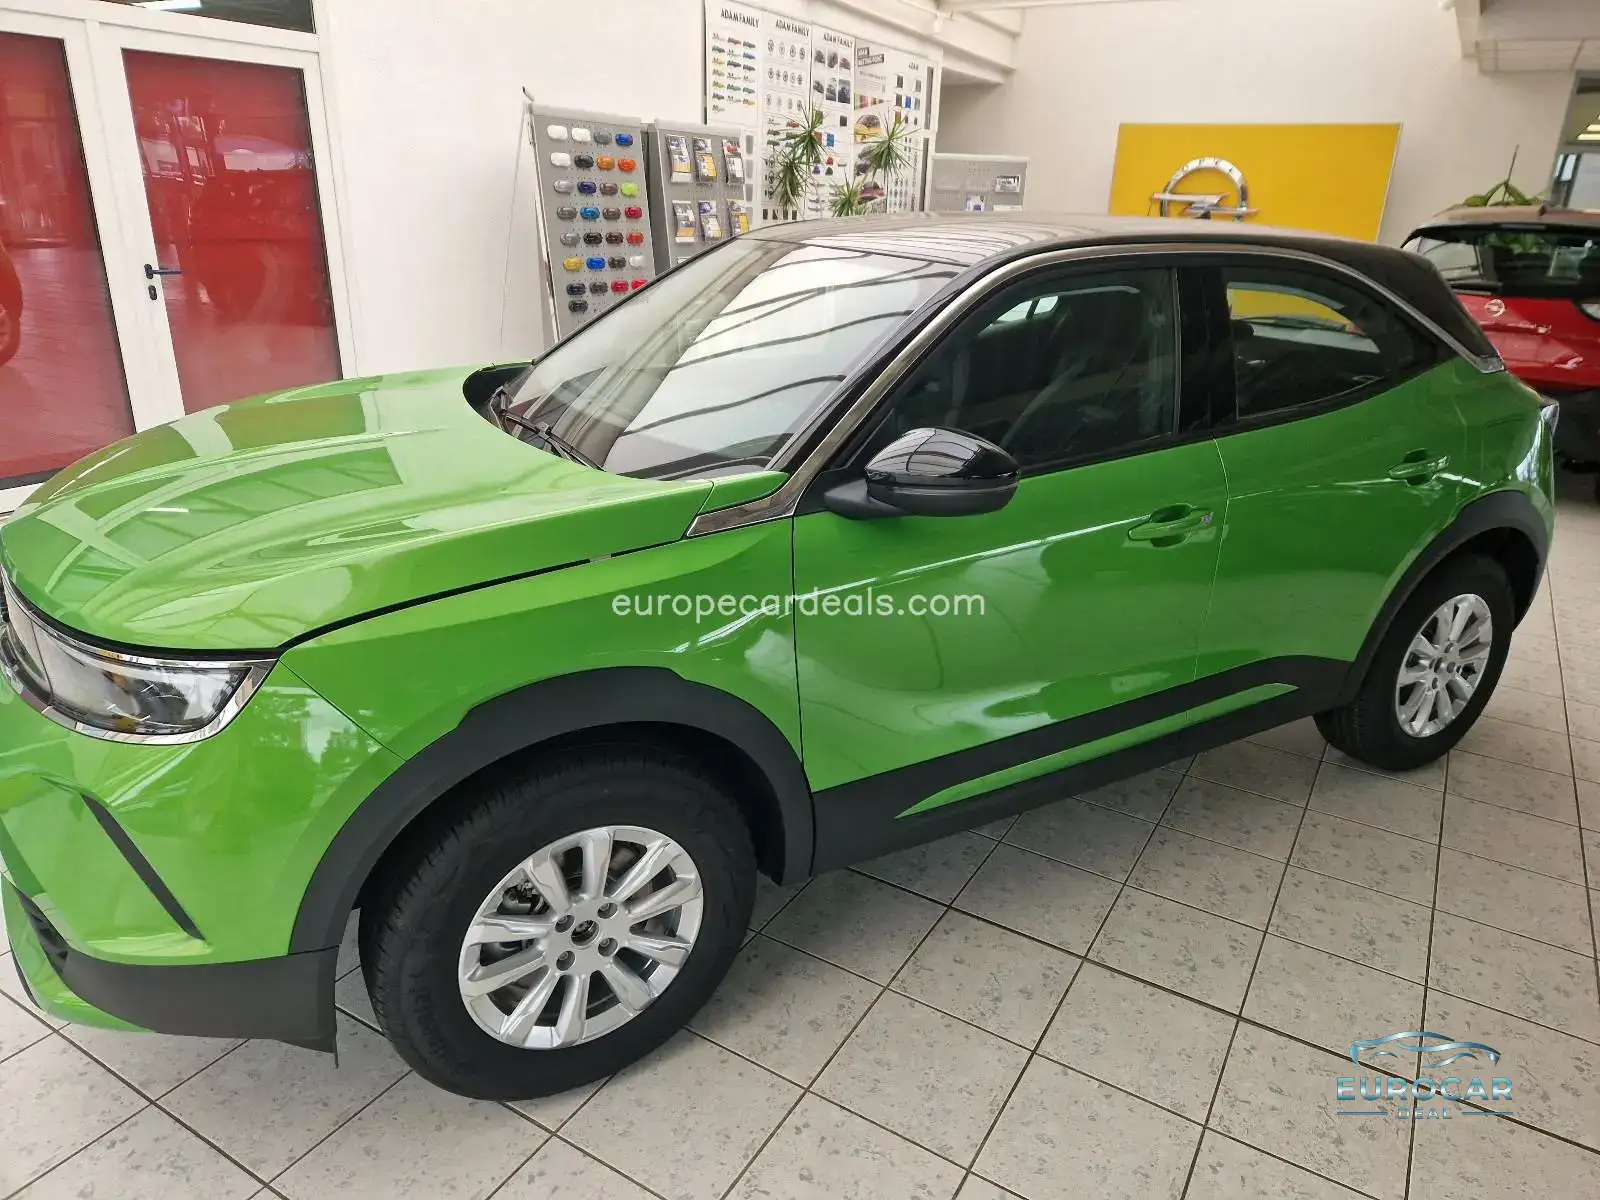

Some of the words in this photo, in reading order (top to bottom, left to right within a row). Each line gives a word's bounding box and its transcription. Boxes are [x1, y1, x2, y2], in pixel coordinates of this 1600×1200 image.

[721, 8, 739, 22] ADAM
[739, 13, 760, 29] FAMILY
[776, 18, 791, 31] ADAM
